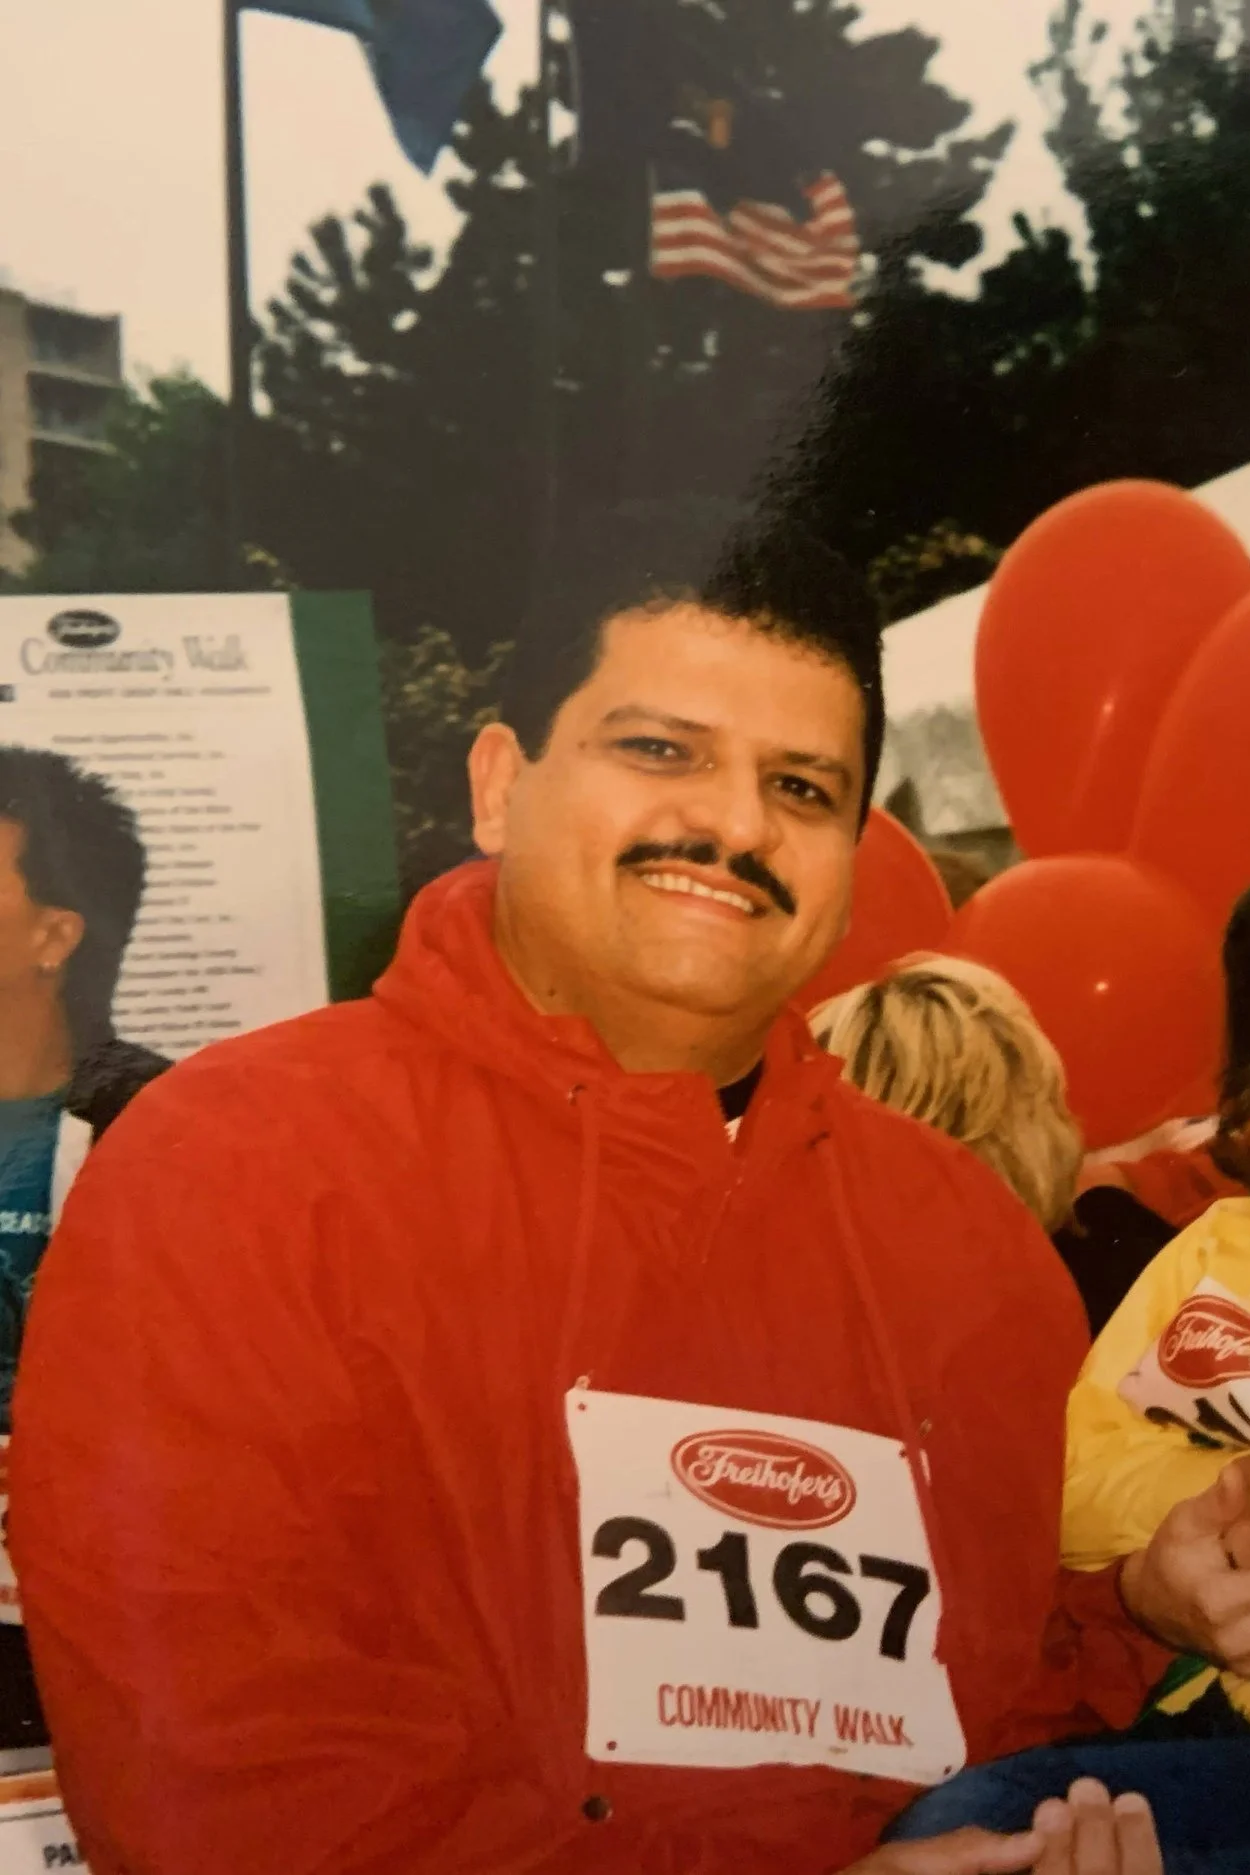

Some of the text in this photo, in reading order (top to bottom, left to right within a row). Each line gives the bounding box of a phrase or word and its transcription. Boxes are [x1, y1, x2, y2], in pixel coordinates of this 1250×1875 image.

[592, 1515, 931, 1662] 2167
[657, 1683, 914, 1747] COMMUNITY WALK
